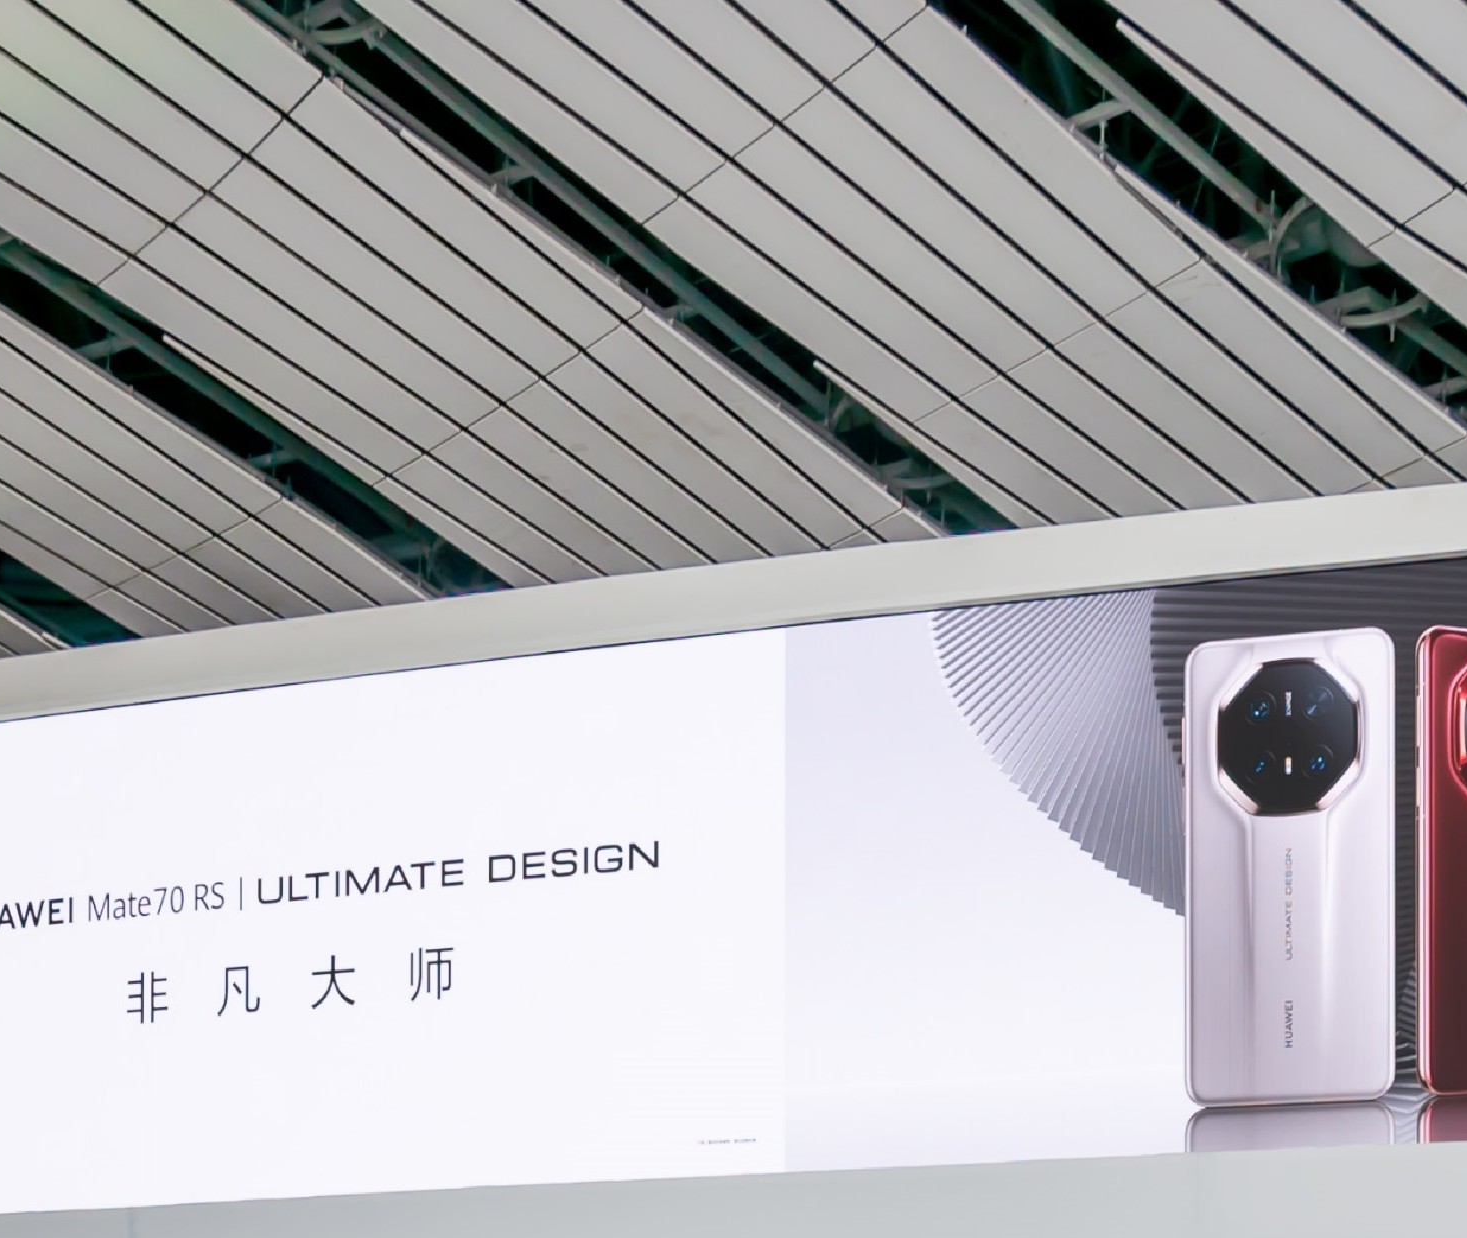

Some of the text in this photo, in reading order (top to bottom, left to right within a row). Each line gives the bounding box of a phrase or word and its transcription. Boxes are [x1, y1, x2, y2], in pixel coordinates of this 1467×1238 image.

[88, 885, 184, 922] Mate70
[195, 882, 224, 911] RS
[258, 859, 464, 904] ULTIMATE
[489, 840, 659, 883] DESIGN
[1285, 847, 1293, 960] ULTIMATE DESIGN
[127, 948, 454, 1024] 非凡大师
[1284, 999, 1293, 1049] HUAWEI
